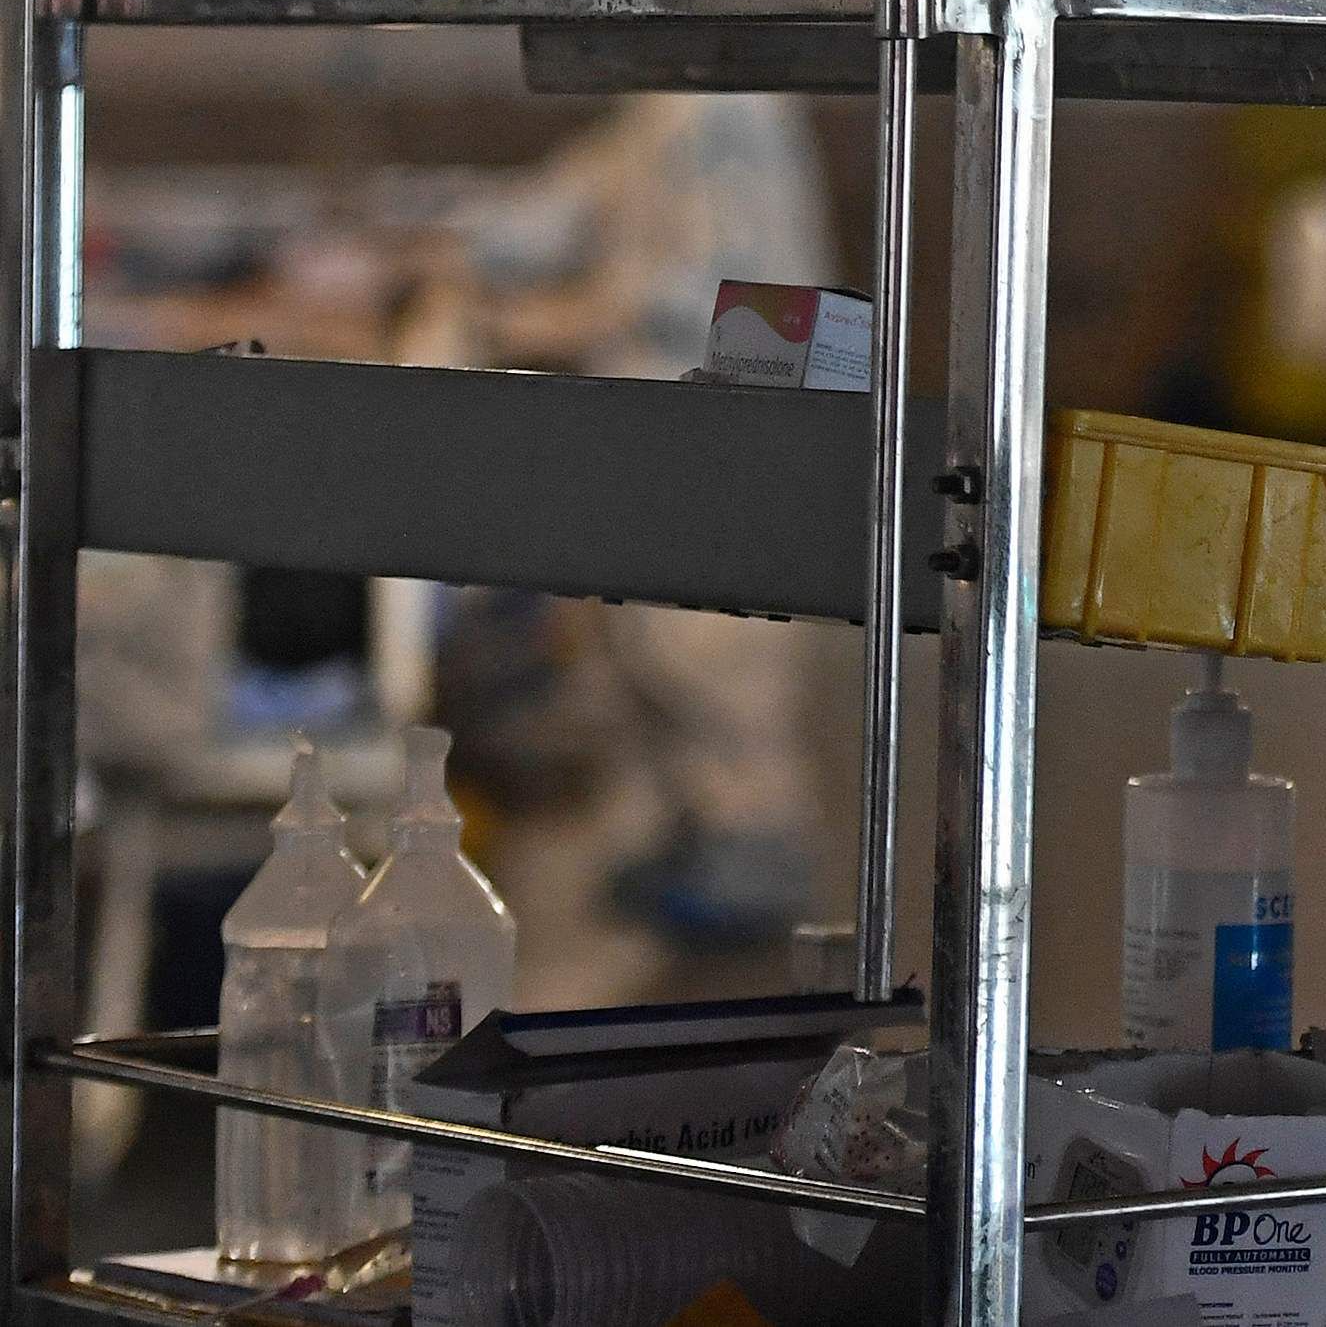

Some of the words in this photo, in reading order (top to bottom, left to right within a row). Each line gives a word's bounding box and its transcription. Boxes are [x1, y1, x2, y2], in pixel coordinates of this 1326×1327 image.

[677, 1118, 735, 1150] Acid
[1191, 1212, 1250, 1246] BP
[1253, 1213, 1312, 1245] One
[1192, 1250, 1231, 1263] FULLY
[1235, 1248, 1310, 1262] AUTOMATIC
[1189, 1266, 1219, 1276] BLOOD
[1221, 1265, 1266, 1275] PRESSURE
[1268, 1263, 1309, 1273] MONITOR
